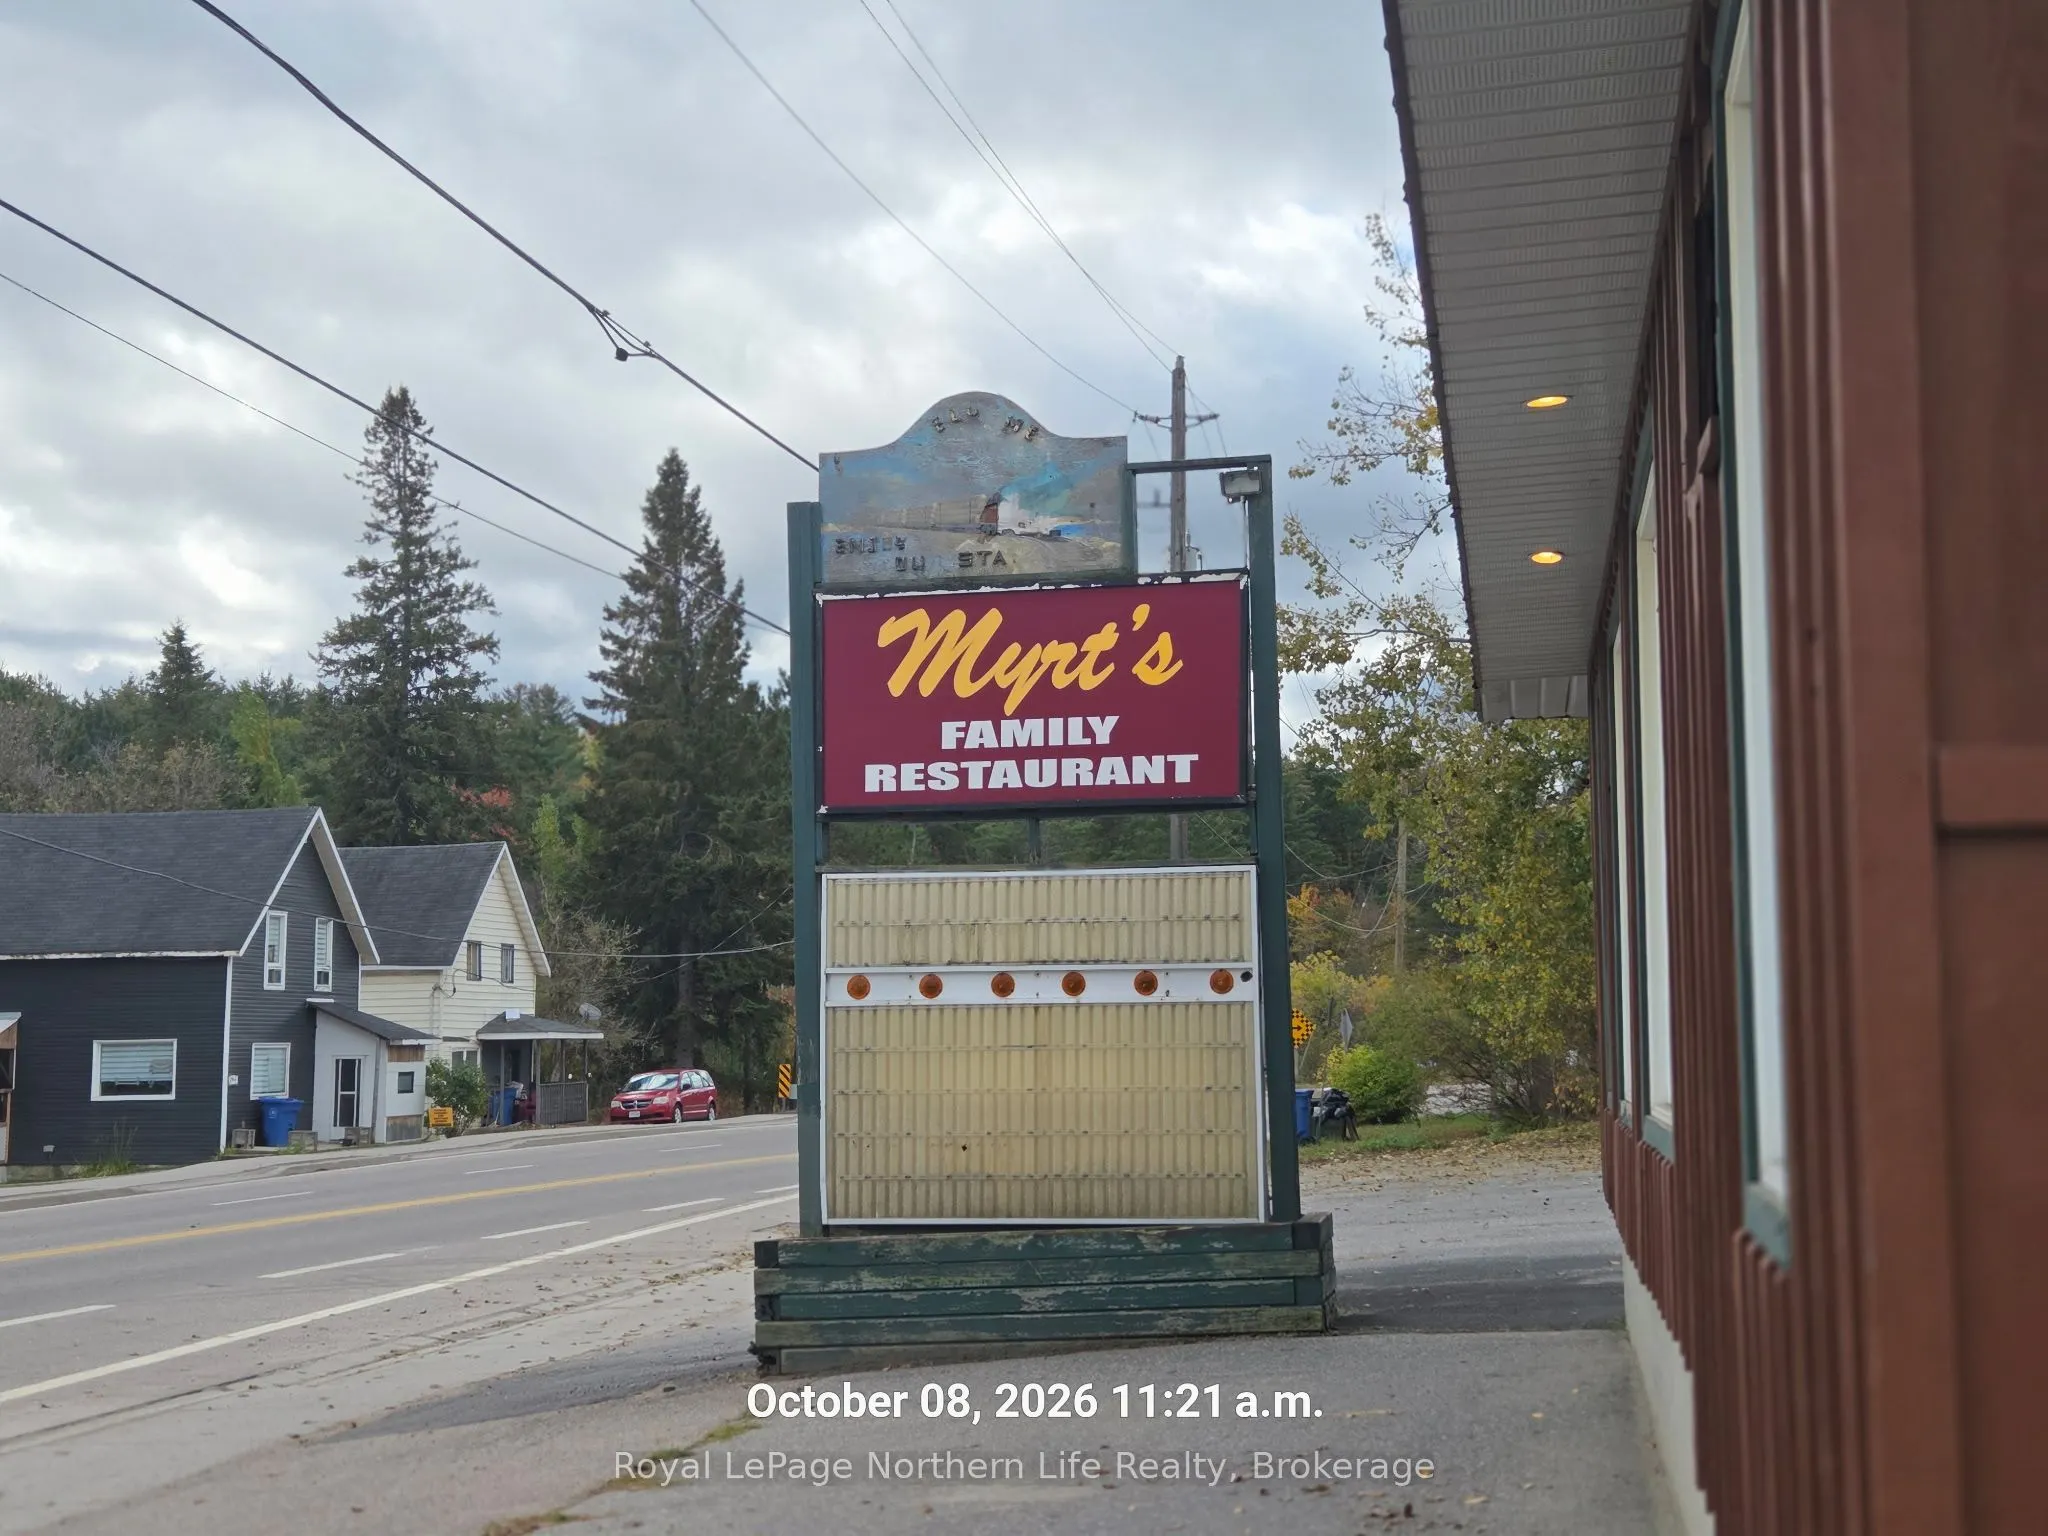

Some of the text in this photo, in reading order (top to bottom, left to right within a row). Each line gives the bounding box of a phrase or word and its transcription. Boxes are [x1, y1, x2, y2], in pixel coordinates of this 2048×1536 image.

[876, 603, 1184, 717] Myrt's
[941, 715, 1120, 750] FAMILY
[864, 753, 1199, 793] RESTAURANT
